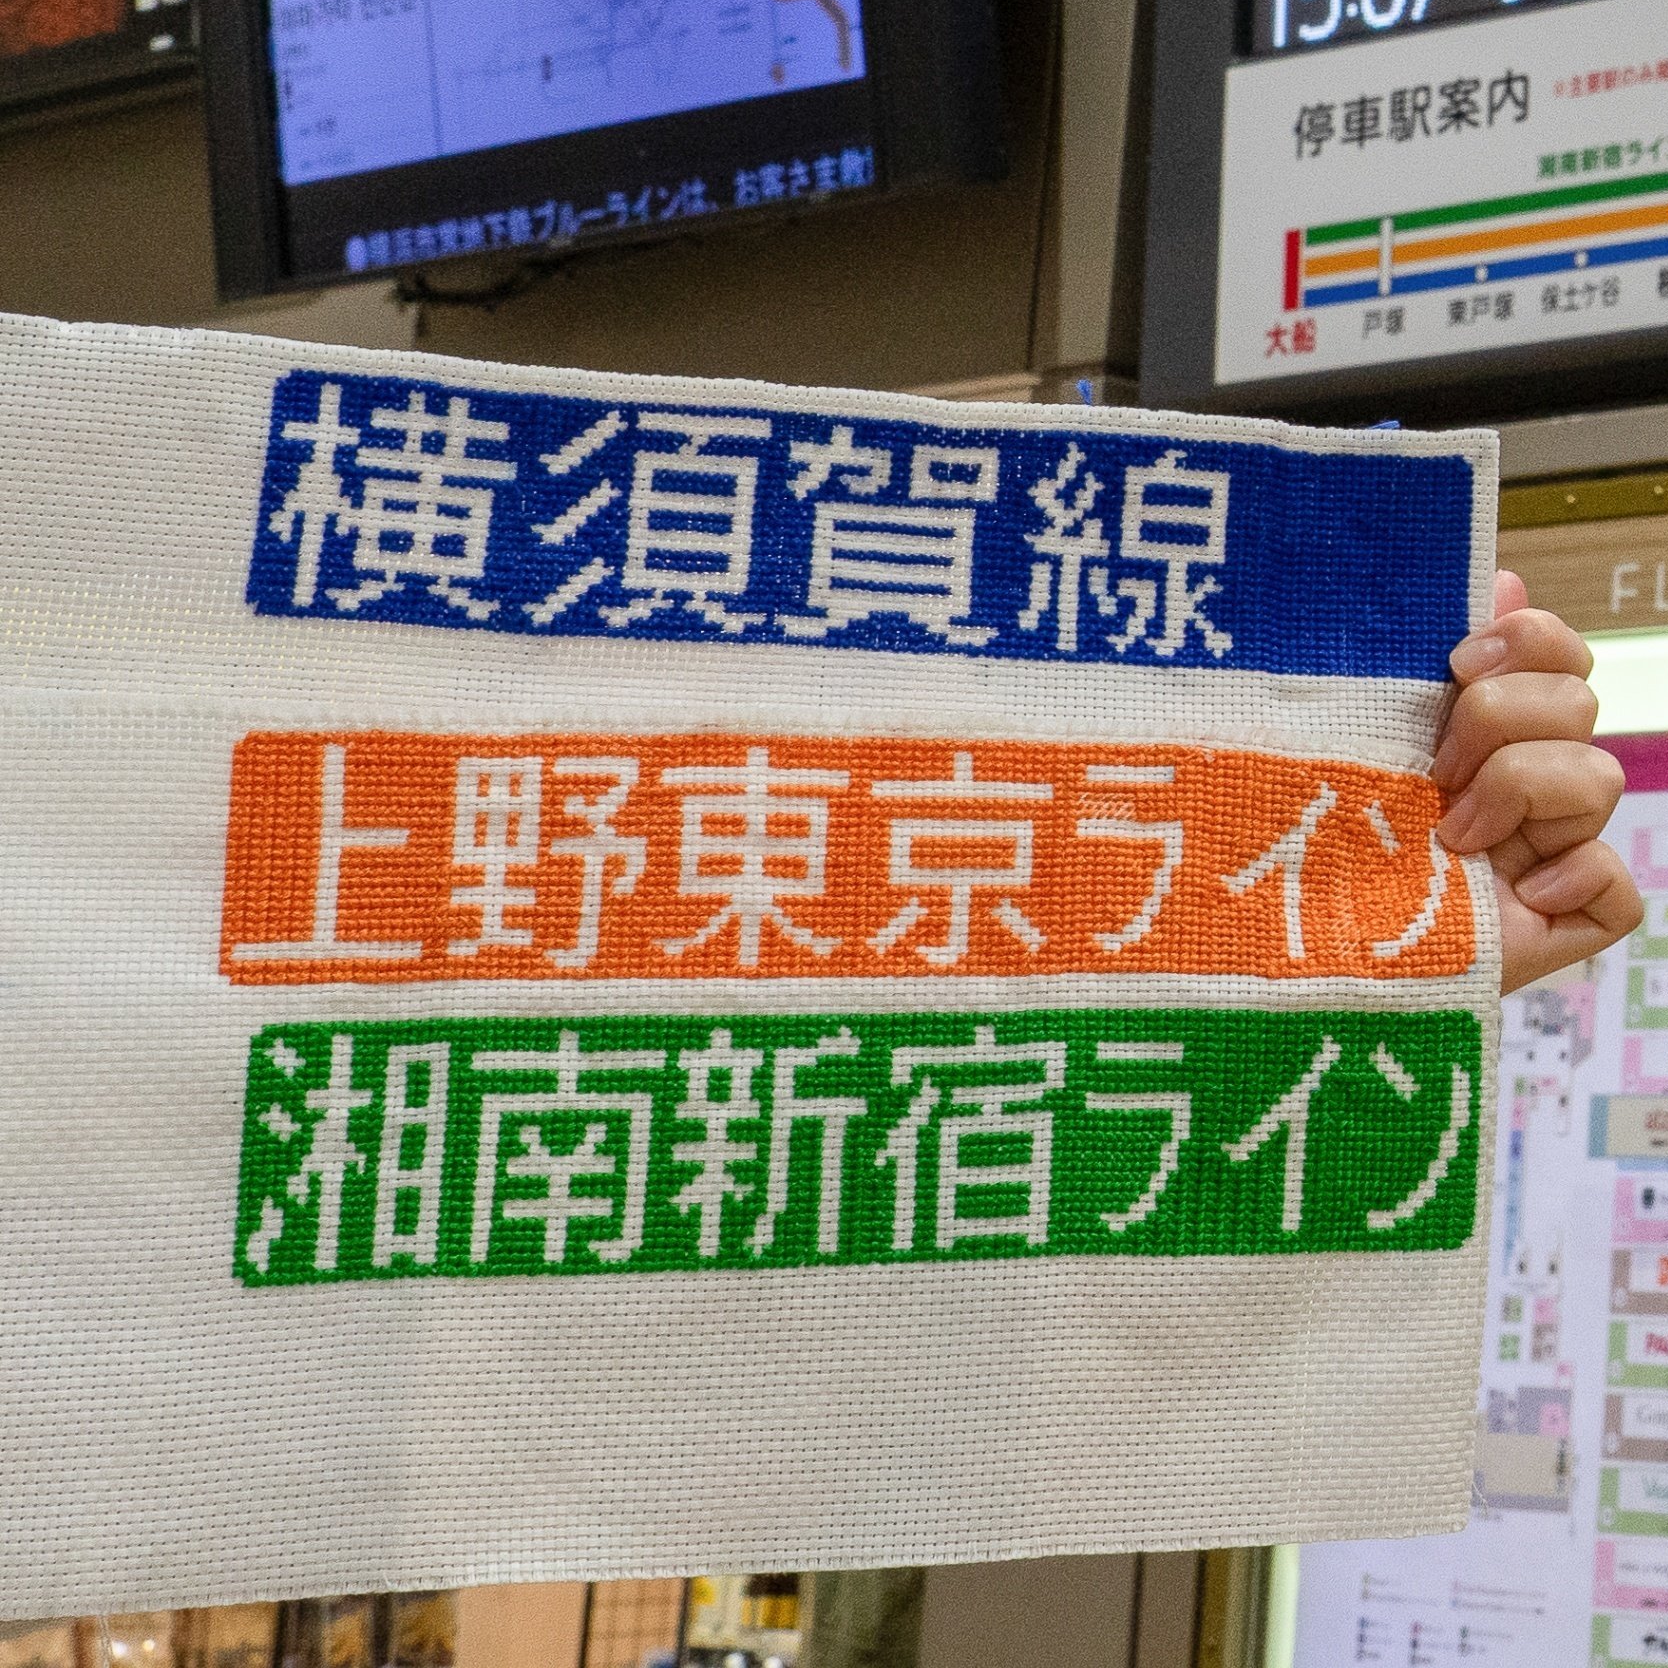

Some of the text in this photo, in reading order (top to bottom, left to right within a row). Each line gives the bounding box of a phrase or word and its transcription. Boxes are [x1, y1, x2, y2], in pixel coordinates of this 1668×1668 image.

[1293, 68, 1531, 161] 停車駅案内
[1265, 317, 1318, 358] 大船
[1361, 306, 1406, 340] 戸塚
[1446, 291, 1516, 327] 東戸塚
[270, 376, 1237, 666] 横須賀線
[228, 739, 1463, 972] 上野東京ライン
[245, 1024, 1477, 1278] 湘南新宿ライン
